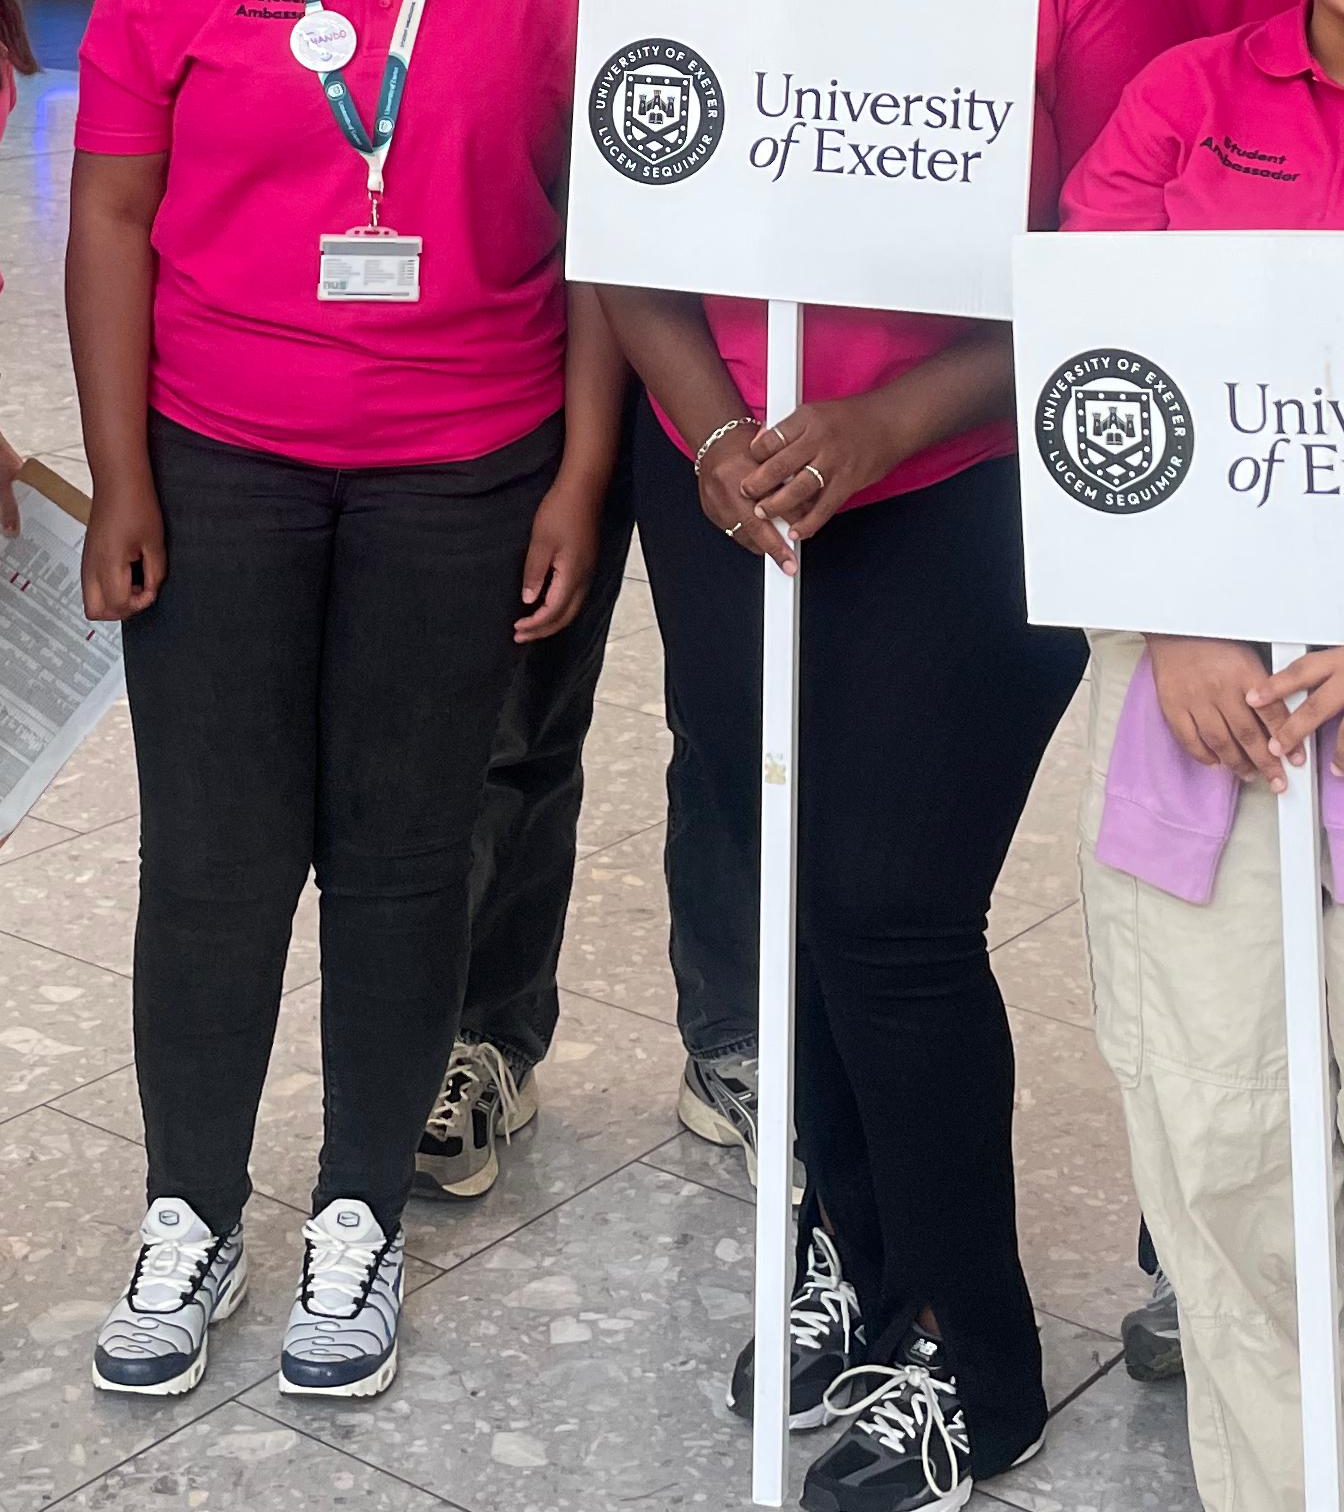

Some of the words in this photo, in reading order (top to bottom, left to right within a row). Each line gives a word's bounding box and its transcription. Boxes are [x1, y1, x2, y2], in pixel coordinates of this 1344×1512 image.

[595, 46, 660, 109] UNIVERSITY
[665, 47, 686, 61] OF
[687, 60, 718, 119] EXETER
[755, 71, 1014, 144] University
[598, 126, 637, 172] LUCEM
[749, 122, 806, 182] of
[813, 128, 983, 183] Exeter
[1223, 136, 1287, 165] Student
[1043, 357, 1110, 431] UNIVERSITY
[1117, 358, 1141, 373] OF
[1144, 372, 1186, 437] EXETER
[1049, 450, 1098, 501] LUCEM
[1105, 455, 1183, 507] SEQUIMUR
[1227, 438, 1290, 508] of
